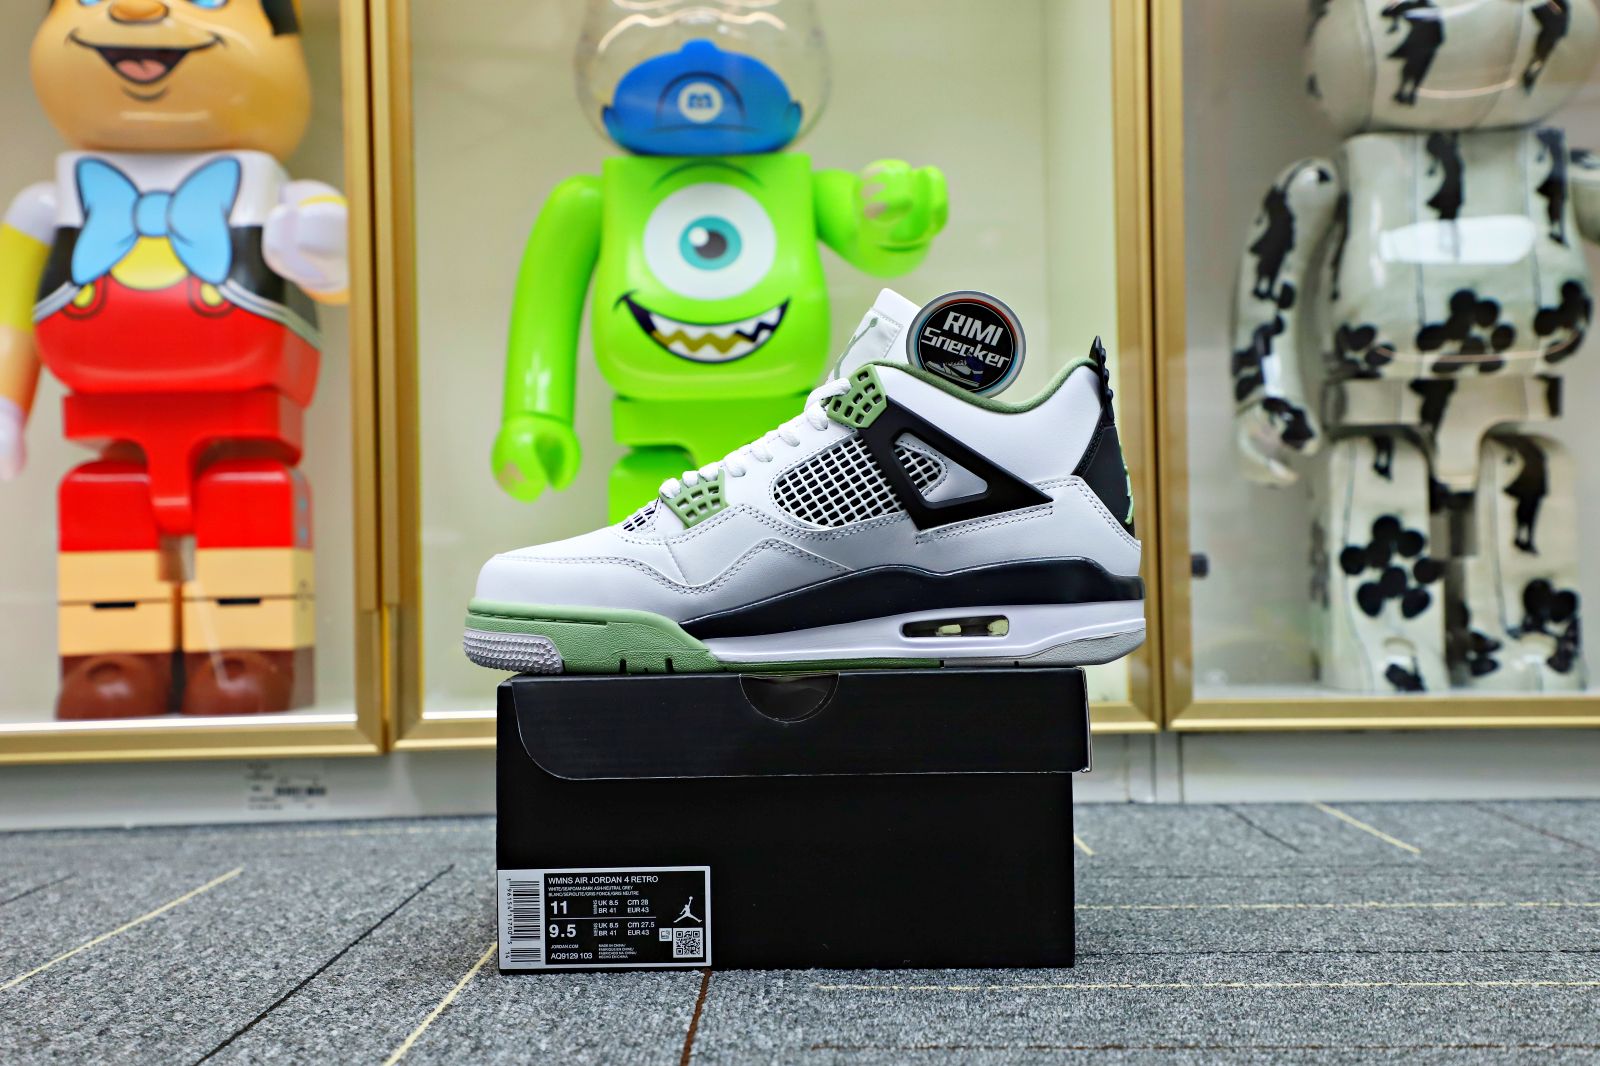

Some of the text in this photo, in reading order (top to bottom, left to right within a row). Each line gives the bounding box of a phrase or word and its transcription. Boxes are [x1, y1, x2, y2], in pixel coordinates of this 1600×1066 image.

[943, 311, 1003, 346] RIMI
[921, 326, 1010, 368] Sneaker
[548, 876, 573, 884] WMNS
[574, 876, 588, 884] AIR
[589, 876, 622, 884] JORDAN
[631, 875, 659, 883] RETRO
[550, 900, 568, 914] 11
[548, 924, 576, 938] 9.5
[550, 952, 579, 960] AQ9129
